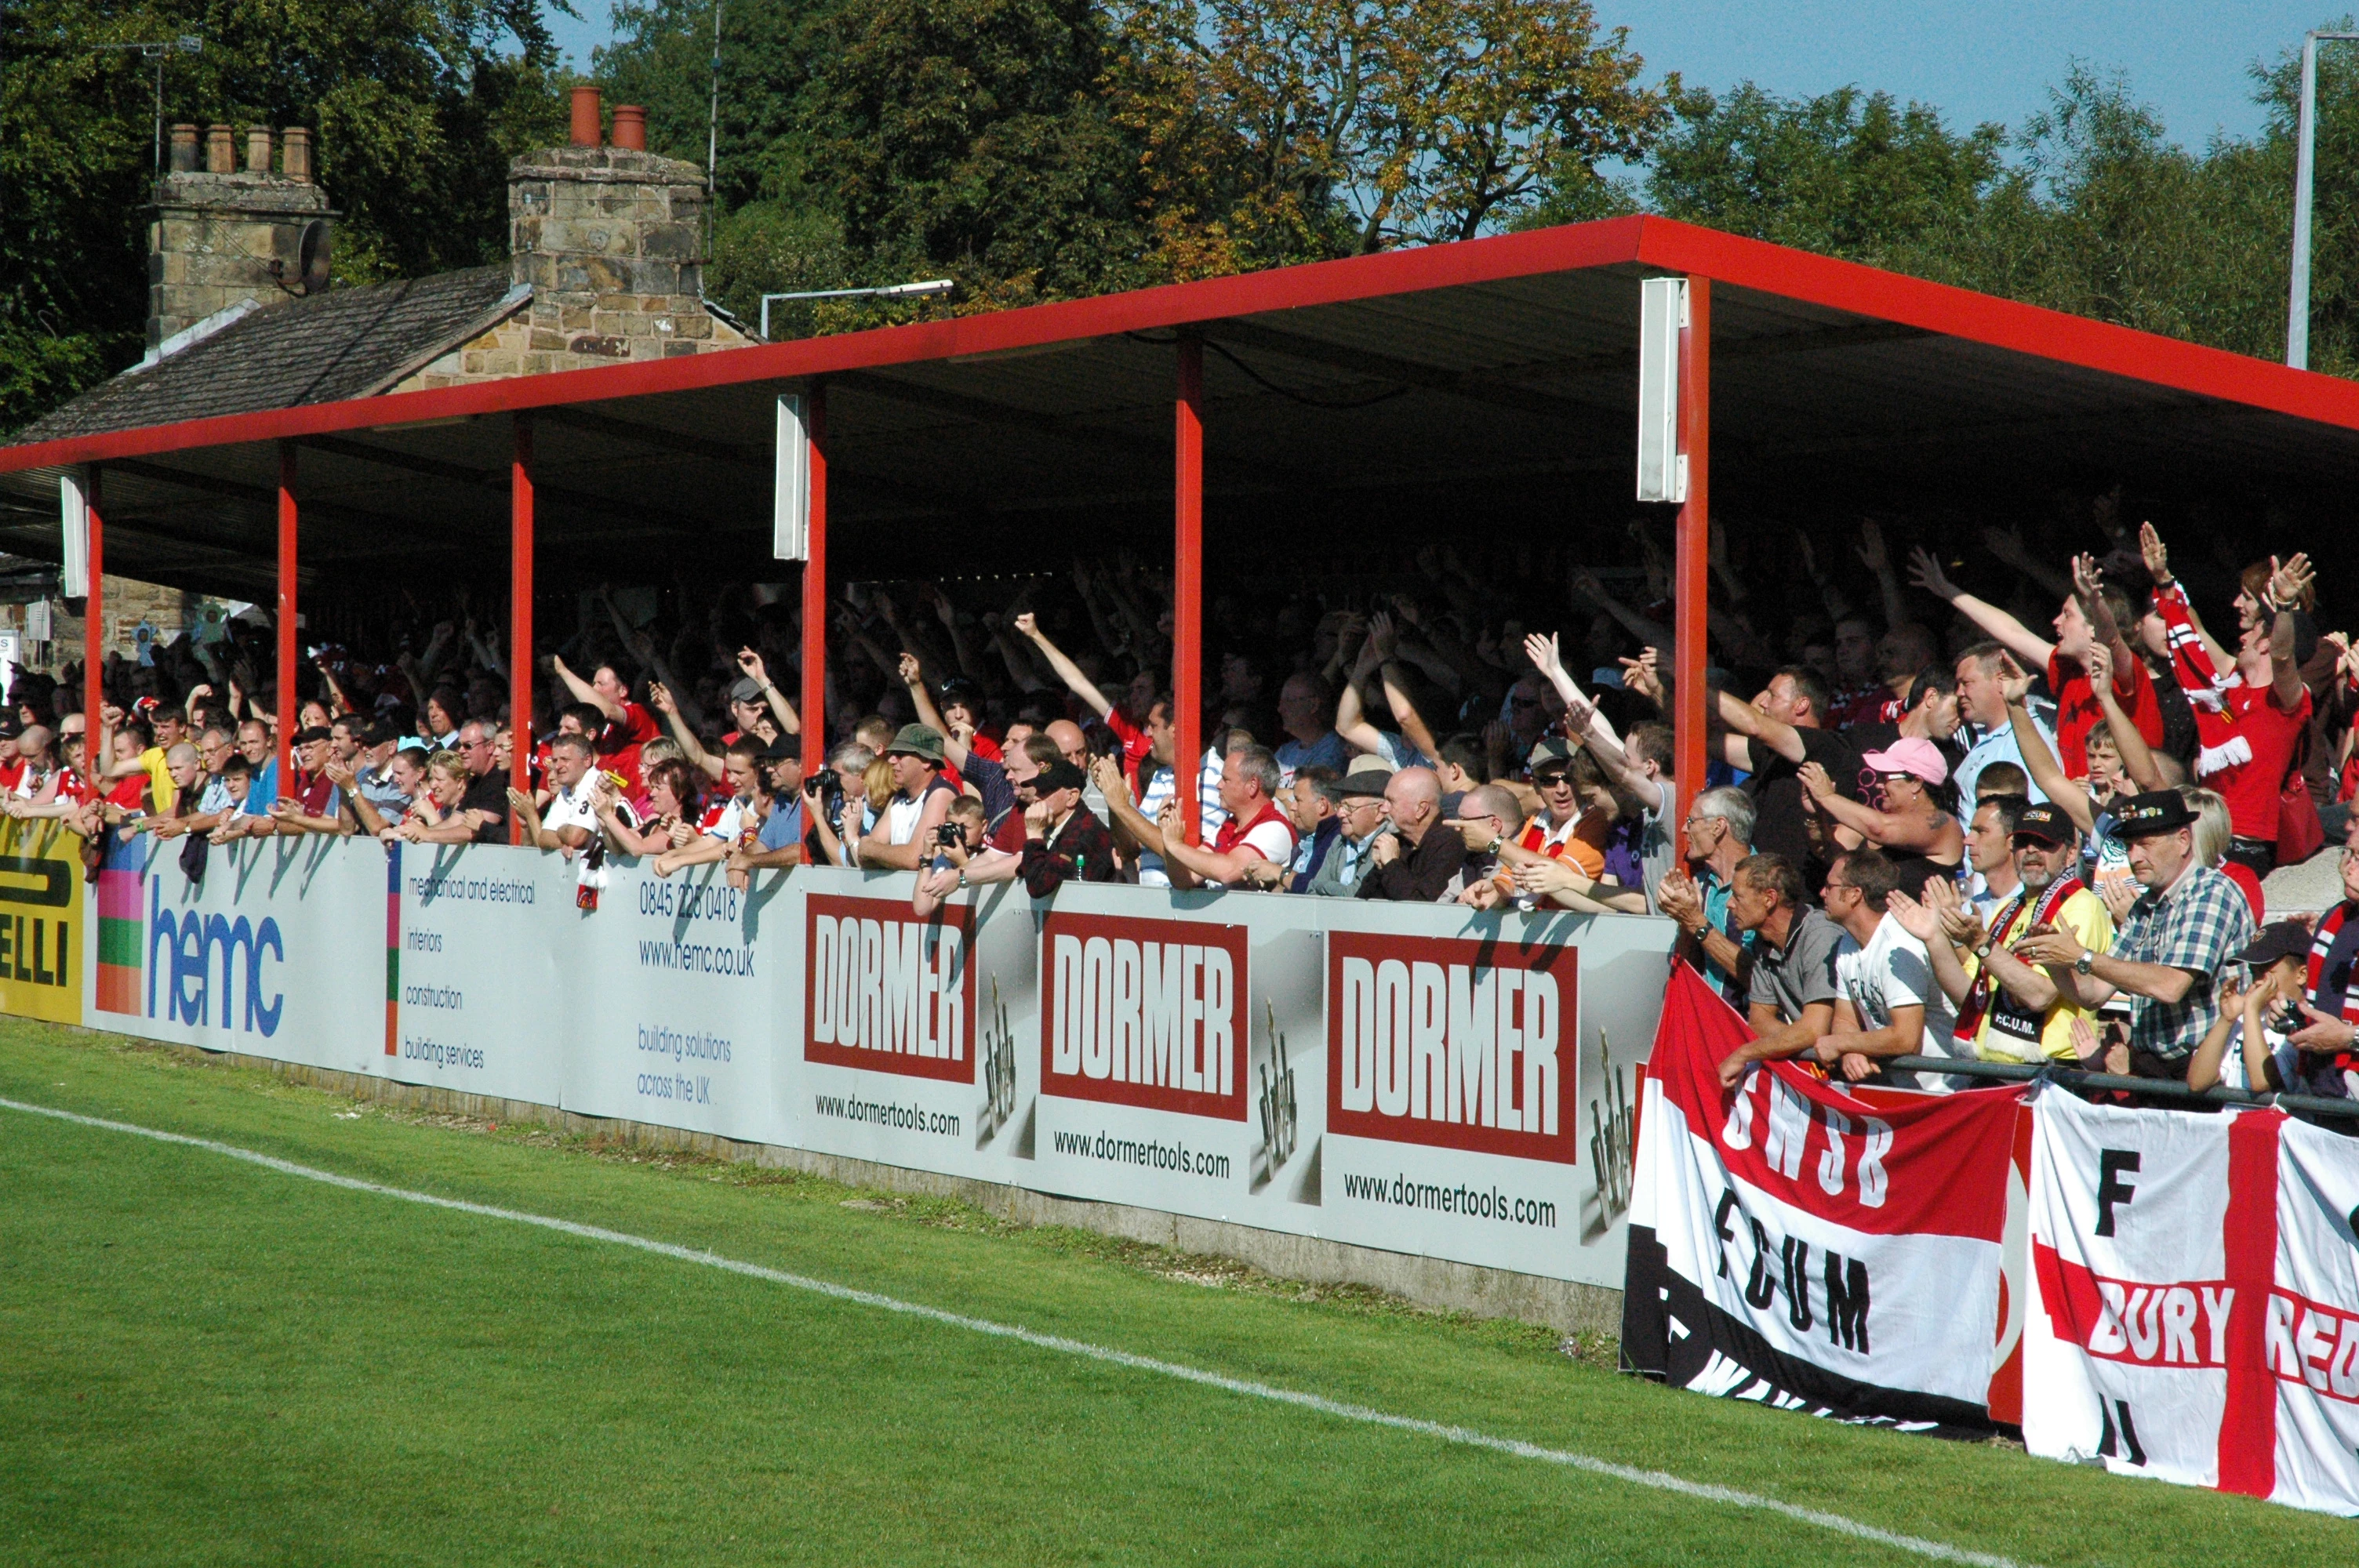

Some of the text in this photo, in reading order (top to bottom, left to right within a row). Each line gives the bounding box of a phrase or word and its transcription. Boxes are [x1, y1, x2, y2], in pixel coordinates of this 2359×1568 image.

[409, 875, 535, 905] mechanical and electrical
[639, 880, 736, 923] 0845 225 0418
[148, 874, 284, 1038] hemc
[407, 927, 442, 953] interiors
[639, 937, 754, 978] www.hemc.co.uk
[406, 983, 463, 1011] construction
[814, 914, 964, 1061] DORMER
[1052, 934, 1234, 1096] DORMER
[405, 1036, 484, 1069] building services
[638, 1023, 731, 1062] building solutions
[1341, 956, 1559, 1136] DORMER
[638, 1072, 710, 1105] across the UK
[815, 1093, 960, 1137] www.dormertools.com
[1054, 1130, 1229, 1179] www.dormertools.com
[1344, 1173, 1556, 1229] www.dormertools.com
[1715, 1187, 1870, 1355] FCUM
[2088, 1281, 2235, 1364] BURY
